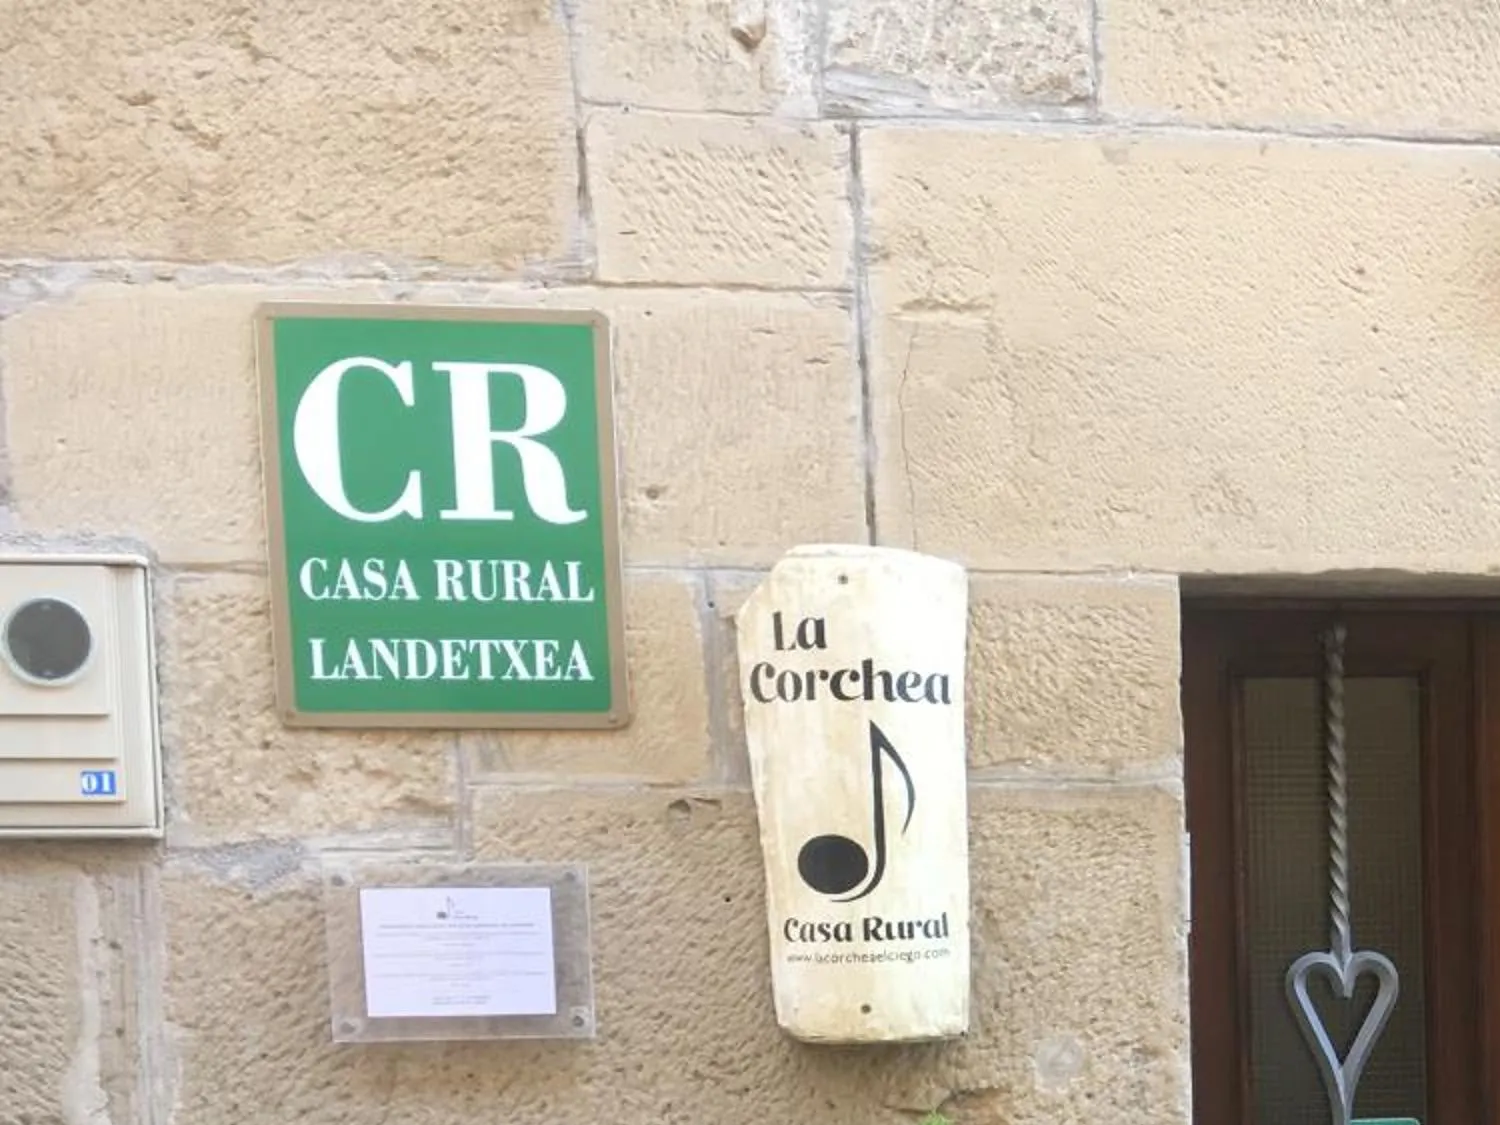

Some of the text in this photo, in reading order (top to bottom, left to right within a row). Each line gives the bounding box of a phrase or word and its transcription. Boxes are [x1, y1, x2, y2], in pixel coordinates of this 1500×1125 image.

[293, 356, 588, 525] CR
[299, 556, 595, 602] CASA RURAL
[772, 611, 827, 651] La
[308, 637, 595, 682] LANDETXEA
[750, 658, 952, 704] Corchea
[81, 772, 113, 793] 01
[783, 911, 949, 943] Casa Rural
